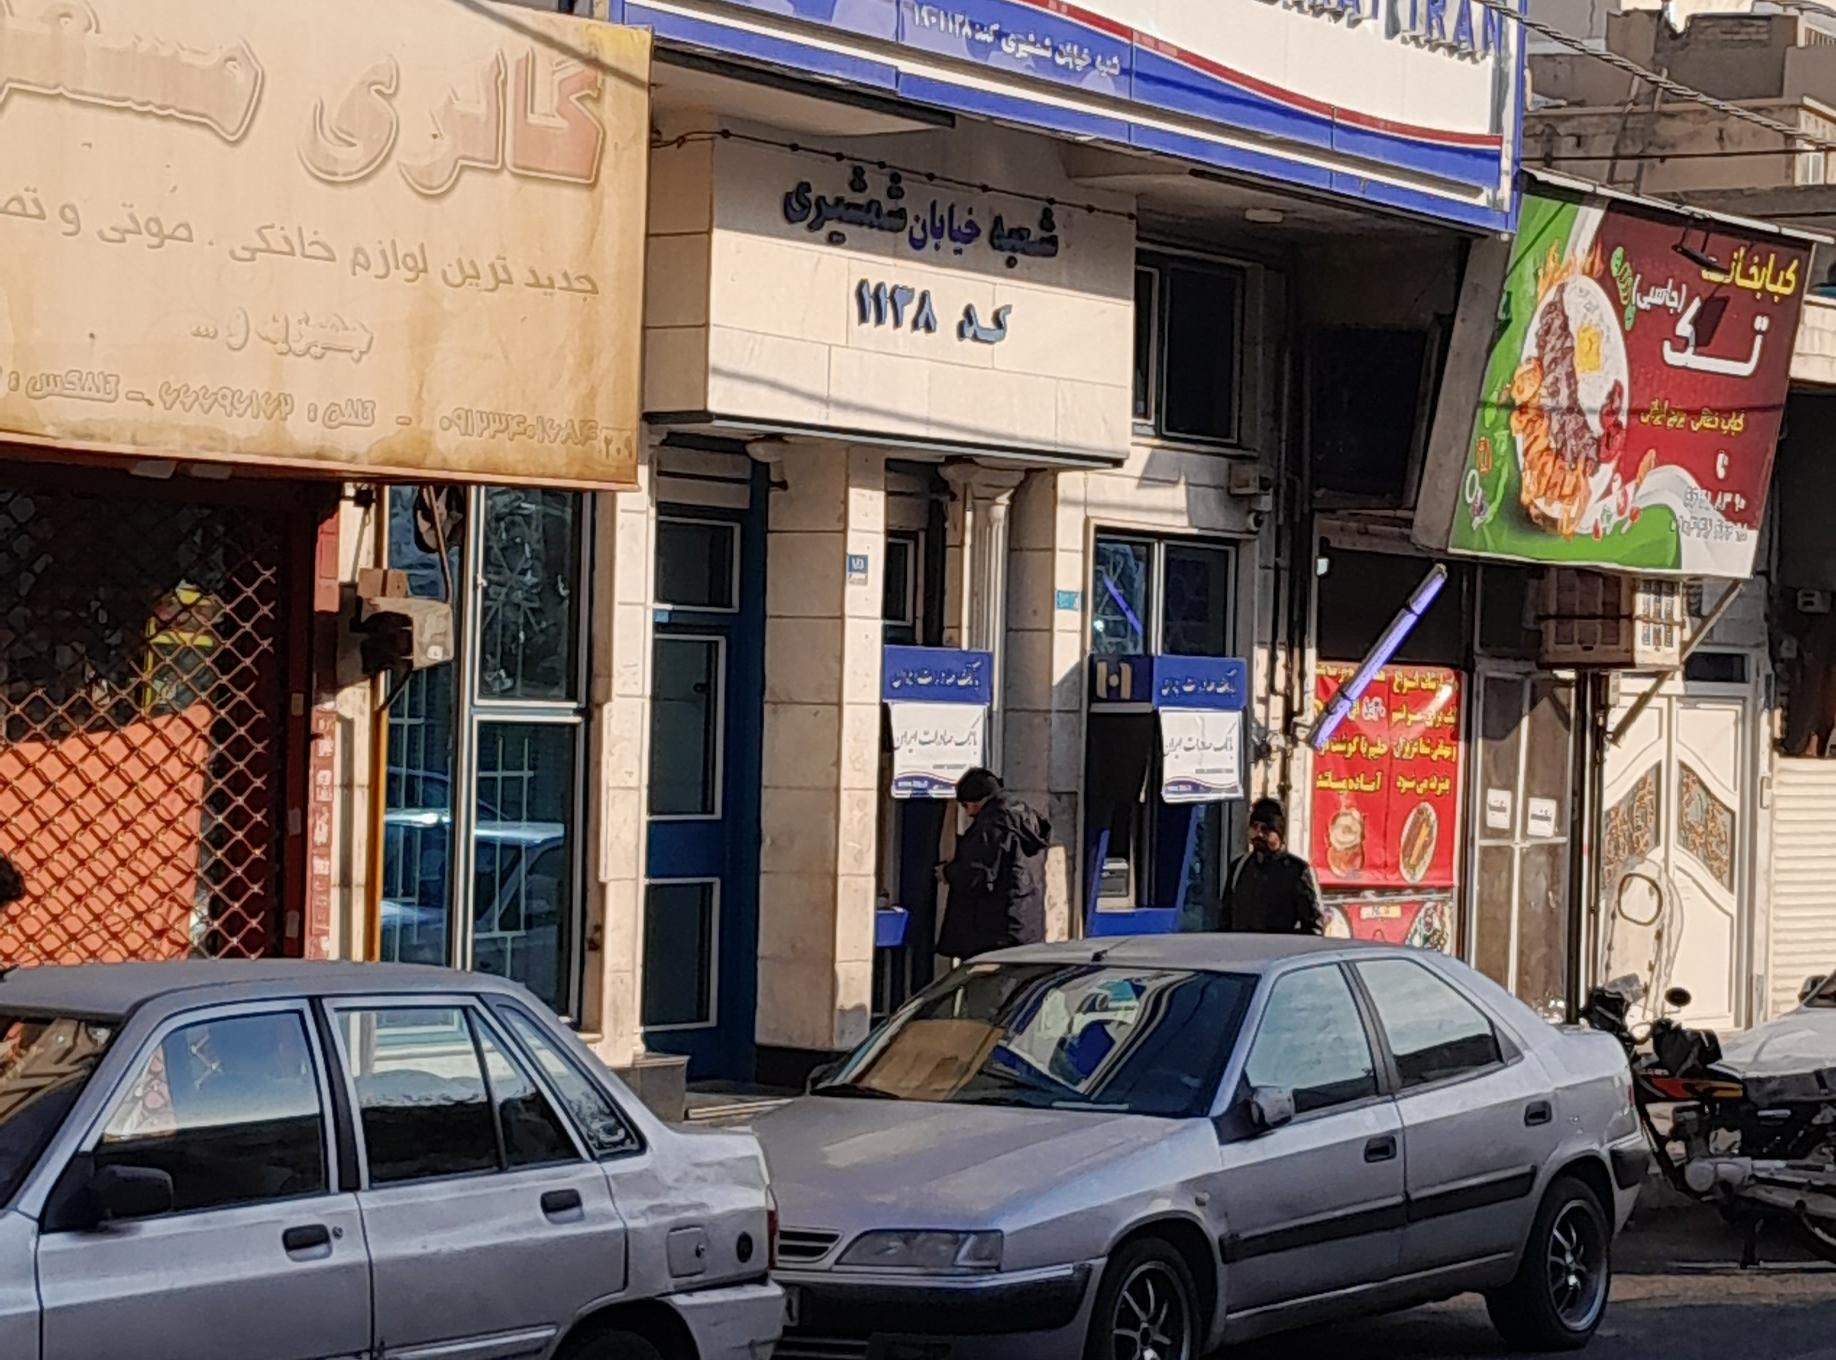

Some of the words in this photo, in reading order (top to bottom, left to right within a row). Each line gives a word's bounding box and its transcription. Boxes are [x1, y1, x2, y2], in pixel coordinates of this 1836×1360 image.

[299, 47, 606, 196] گالری
[59, 202, 82, 237] و
[783, 165, 907, 245] شمشیری
[909, 198, 981, 256] خیابان
[351, 239, 429, 283] لوازم
[990, 206, 1059, 268] شعبه
[956, 303, 1014, 346] کد
